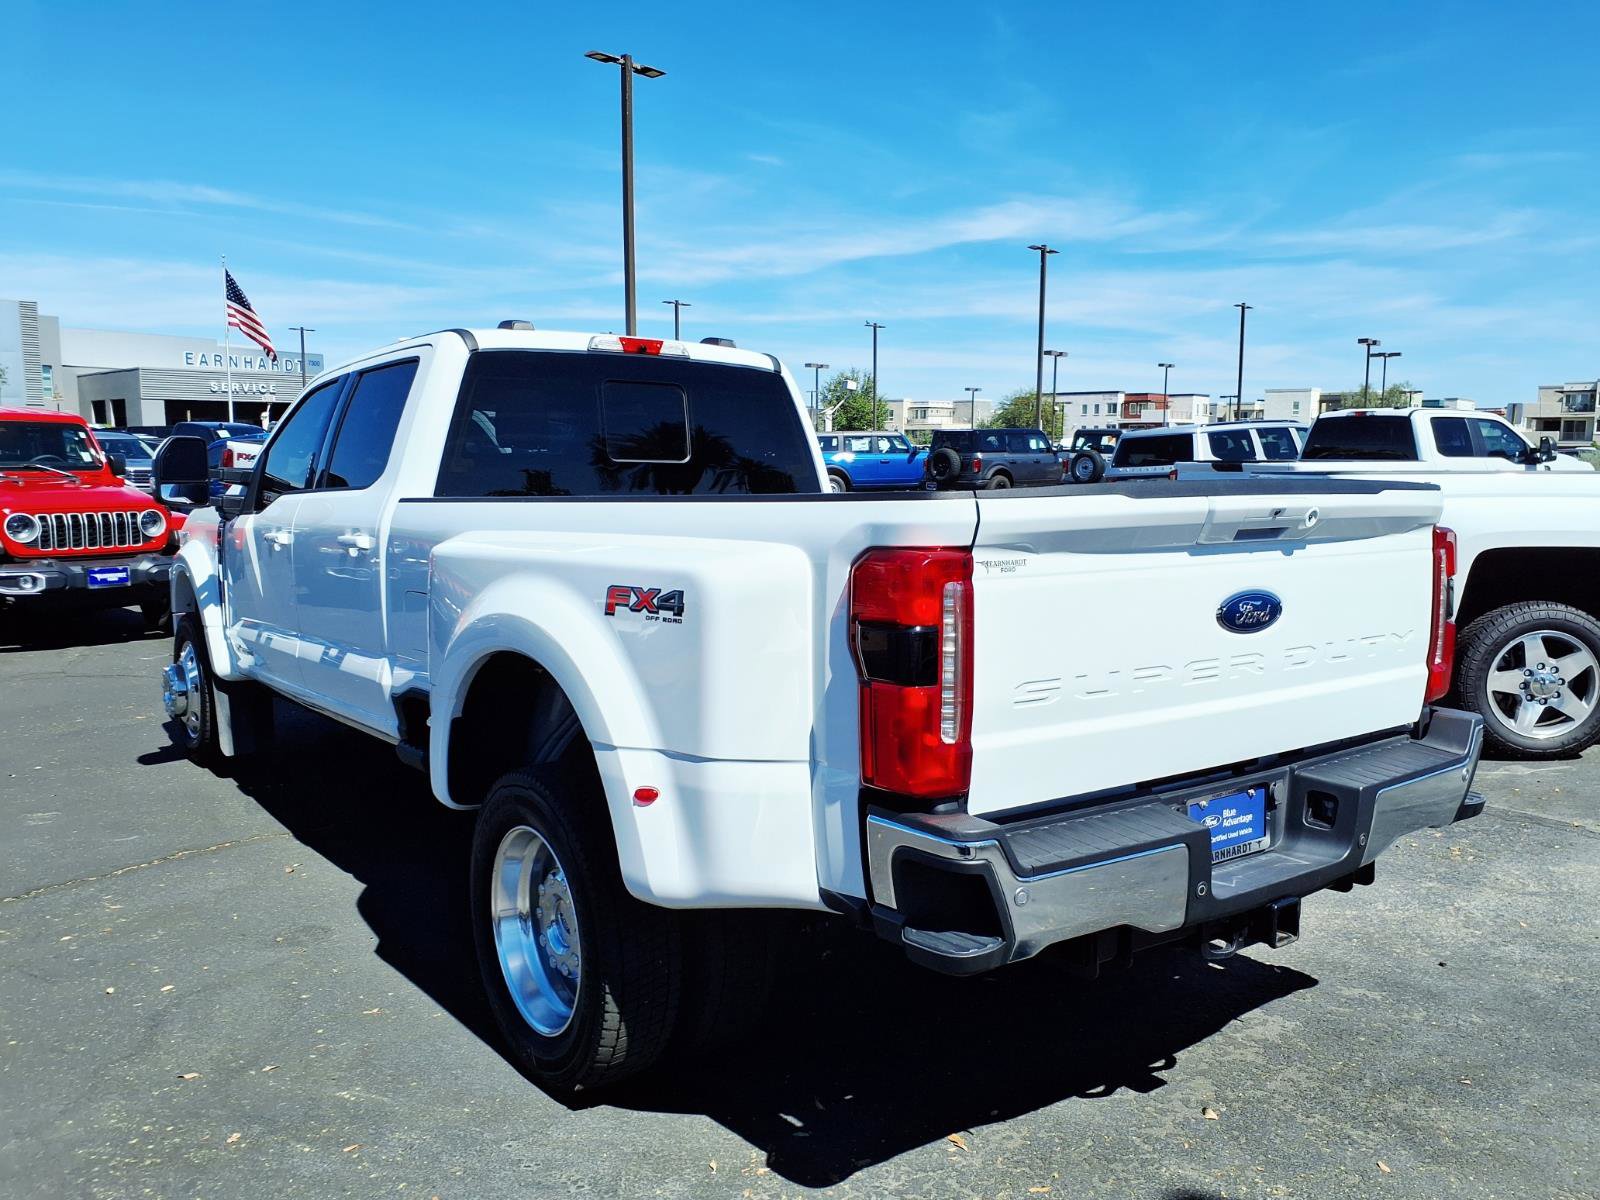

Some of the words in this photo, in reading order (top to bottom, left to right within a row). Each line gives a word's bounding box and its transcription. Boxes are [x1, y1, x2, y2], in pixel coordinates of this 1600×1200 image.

[185, 352, 303, 372] EARNHARDT
[210, 382, 277, 394] SERVICE
[604, 584, 685, 617] FX4
[1012, 653, 1265, 709] SUPER
[1282, 629, 1414, 671] DUTY
[1222, 808, 1237, 818] Blue
[1222, 813, 1253, 827] Advantage
[1228, 830, 1239, 838] Used
[1211, 843, 1252, 861] ARNHARDT
